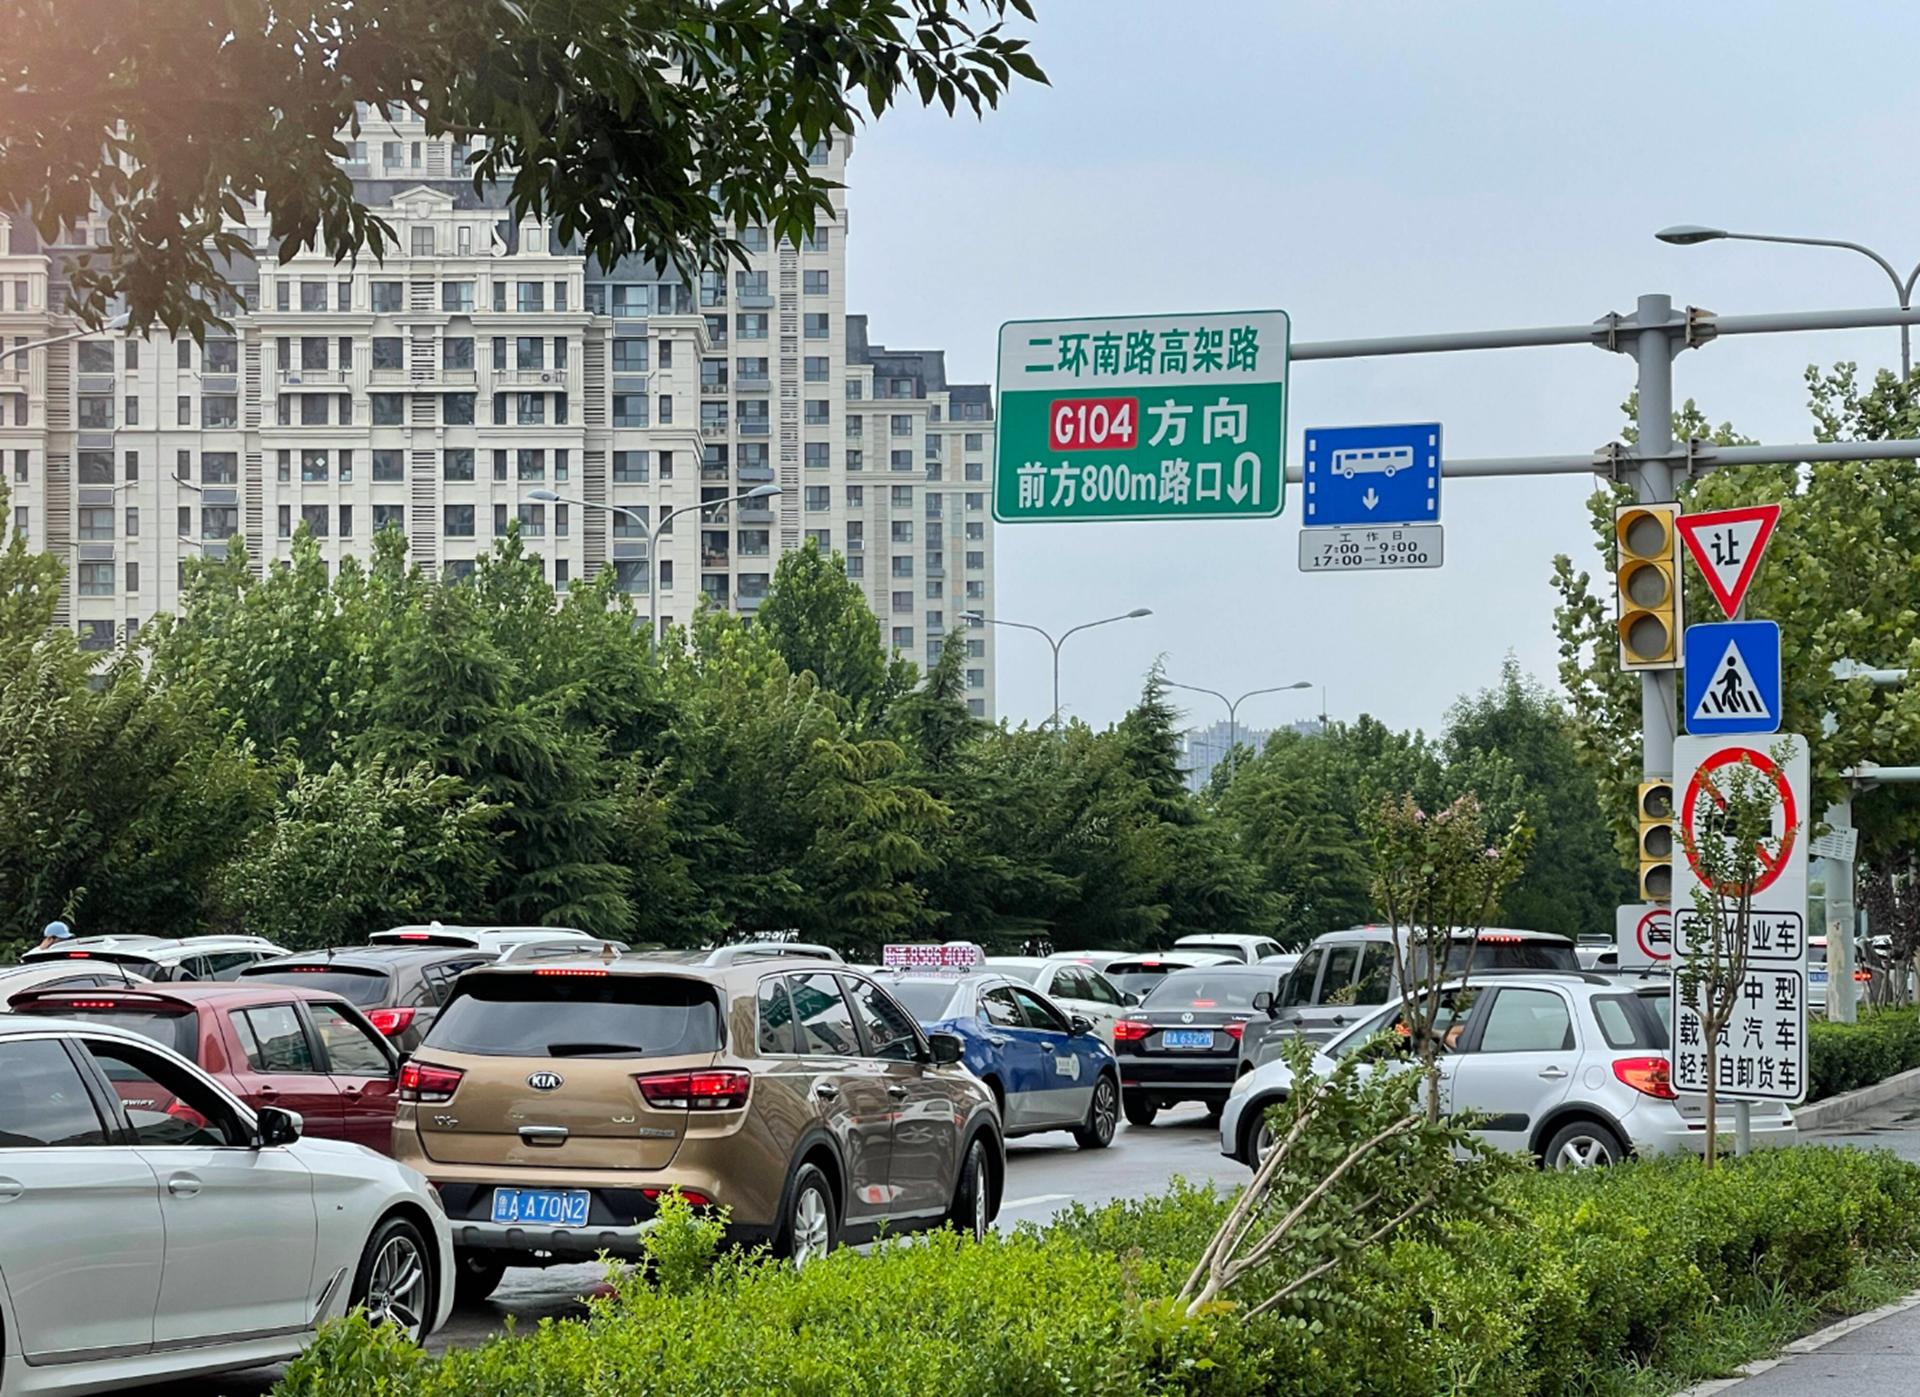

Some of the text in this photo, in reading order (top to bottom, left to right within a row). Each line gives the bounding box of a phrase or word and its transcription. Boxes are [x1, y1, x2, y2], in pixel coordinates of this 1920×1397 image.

[1025, 325, 1260, 377] 二环南路高架路
[1054, 397, 1248, 447] G104 方向
[1016, 457, 1222, 508] 前方800m路口
[1339, 531, 1402, 543] 工作日
[1711, 529, 1740, 565] 让
[531, 1074, 556, 1088] KIA
